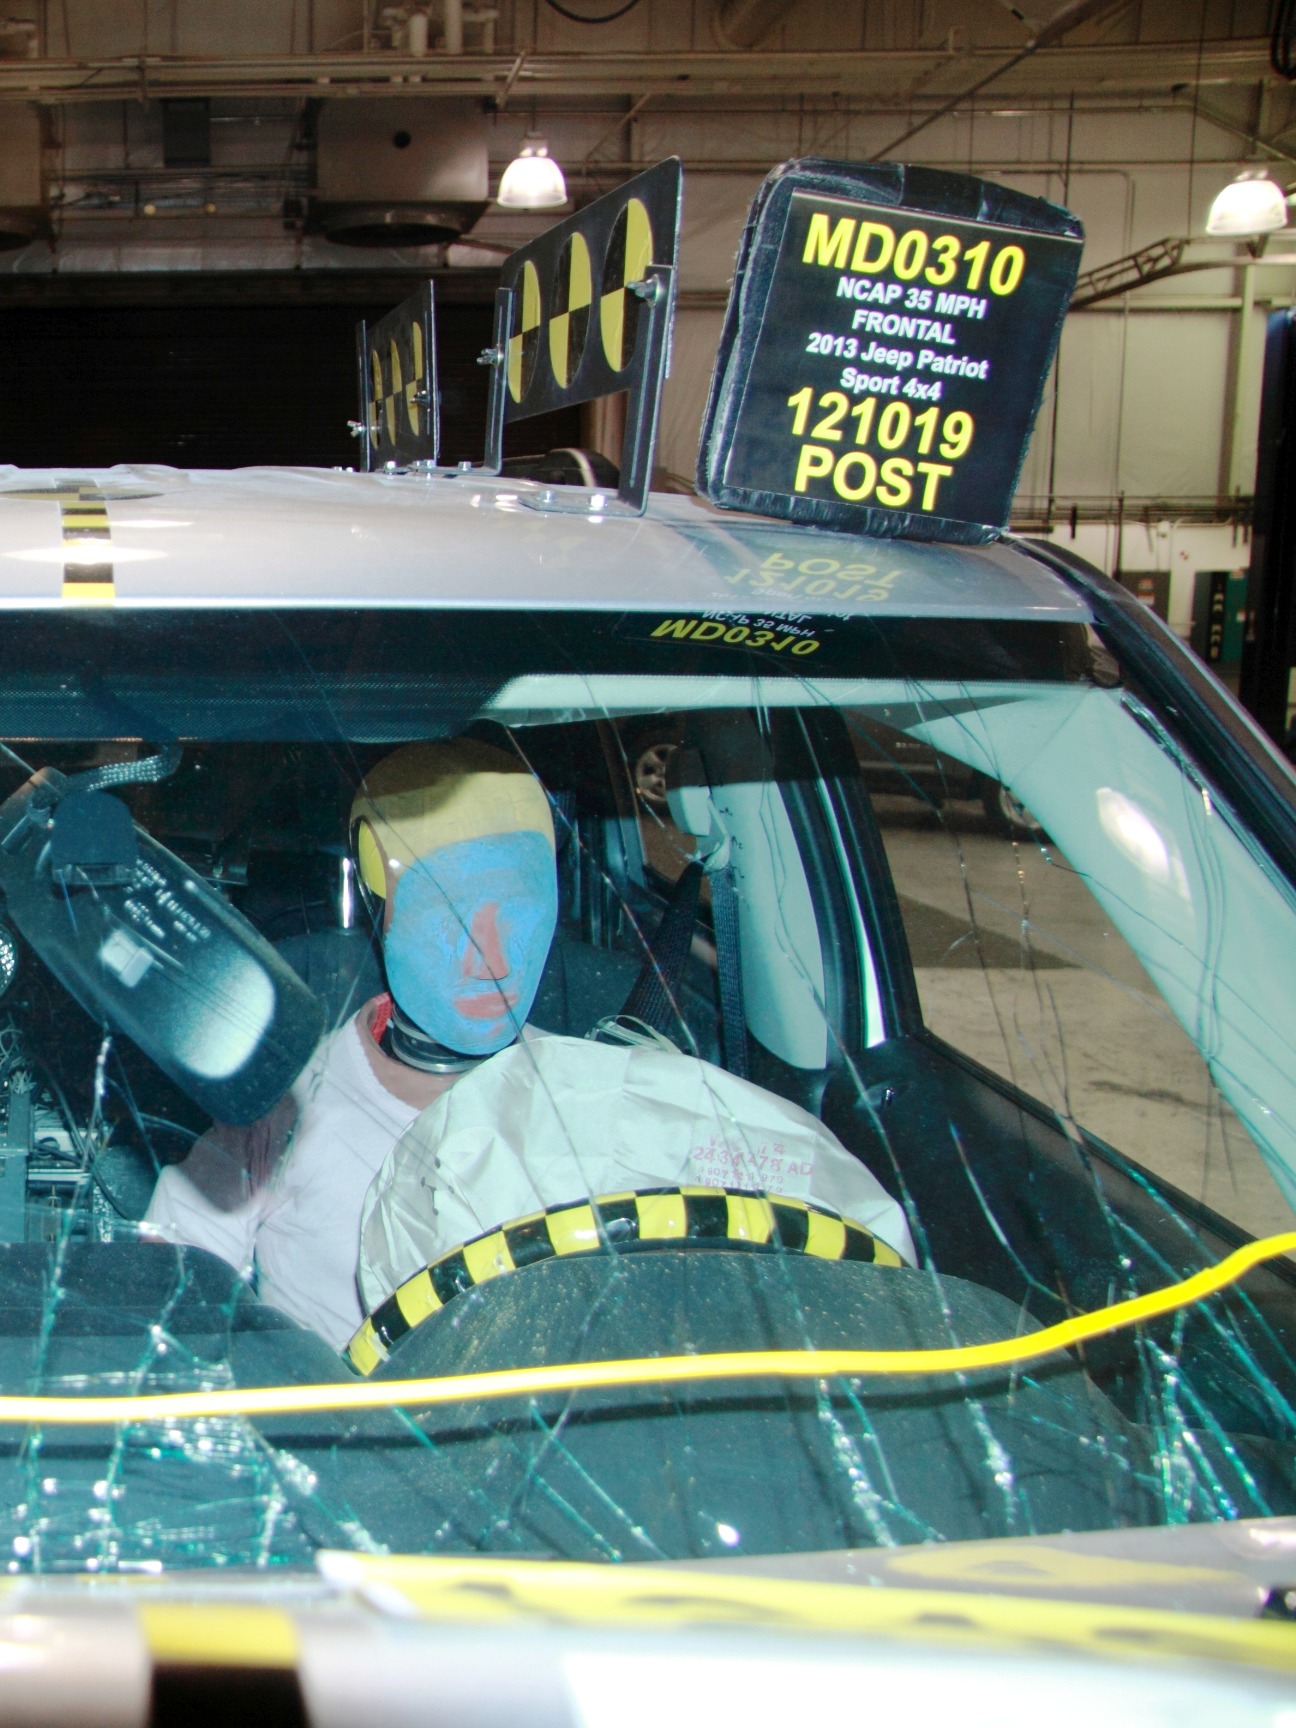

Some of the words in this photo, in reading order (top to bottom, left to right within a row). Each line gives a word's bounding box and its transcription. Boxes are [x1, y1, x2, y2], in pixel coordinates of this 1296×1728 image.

[802, 212, 1026, 296] MD0310
[836, 276, 902, 306] NCAP
[905, 287, 930, 309] 35
[934, 293, 987, 320] MPH
[851, 309, 956, 345] FRONTAL
[806, 332, 857, 360] 2013
[860, 342, 913, 371] Jeep
[917, 351, 989, 380] Patriot
[840, 367, 900, 397] Sport
[902, 377, 942, 401] 4x4
[787, 386, 975, 460] 121019
[793, 444, 953, 512] POST
